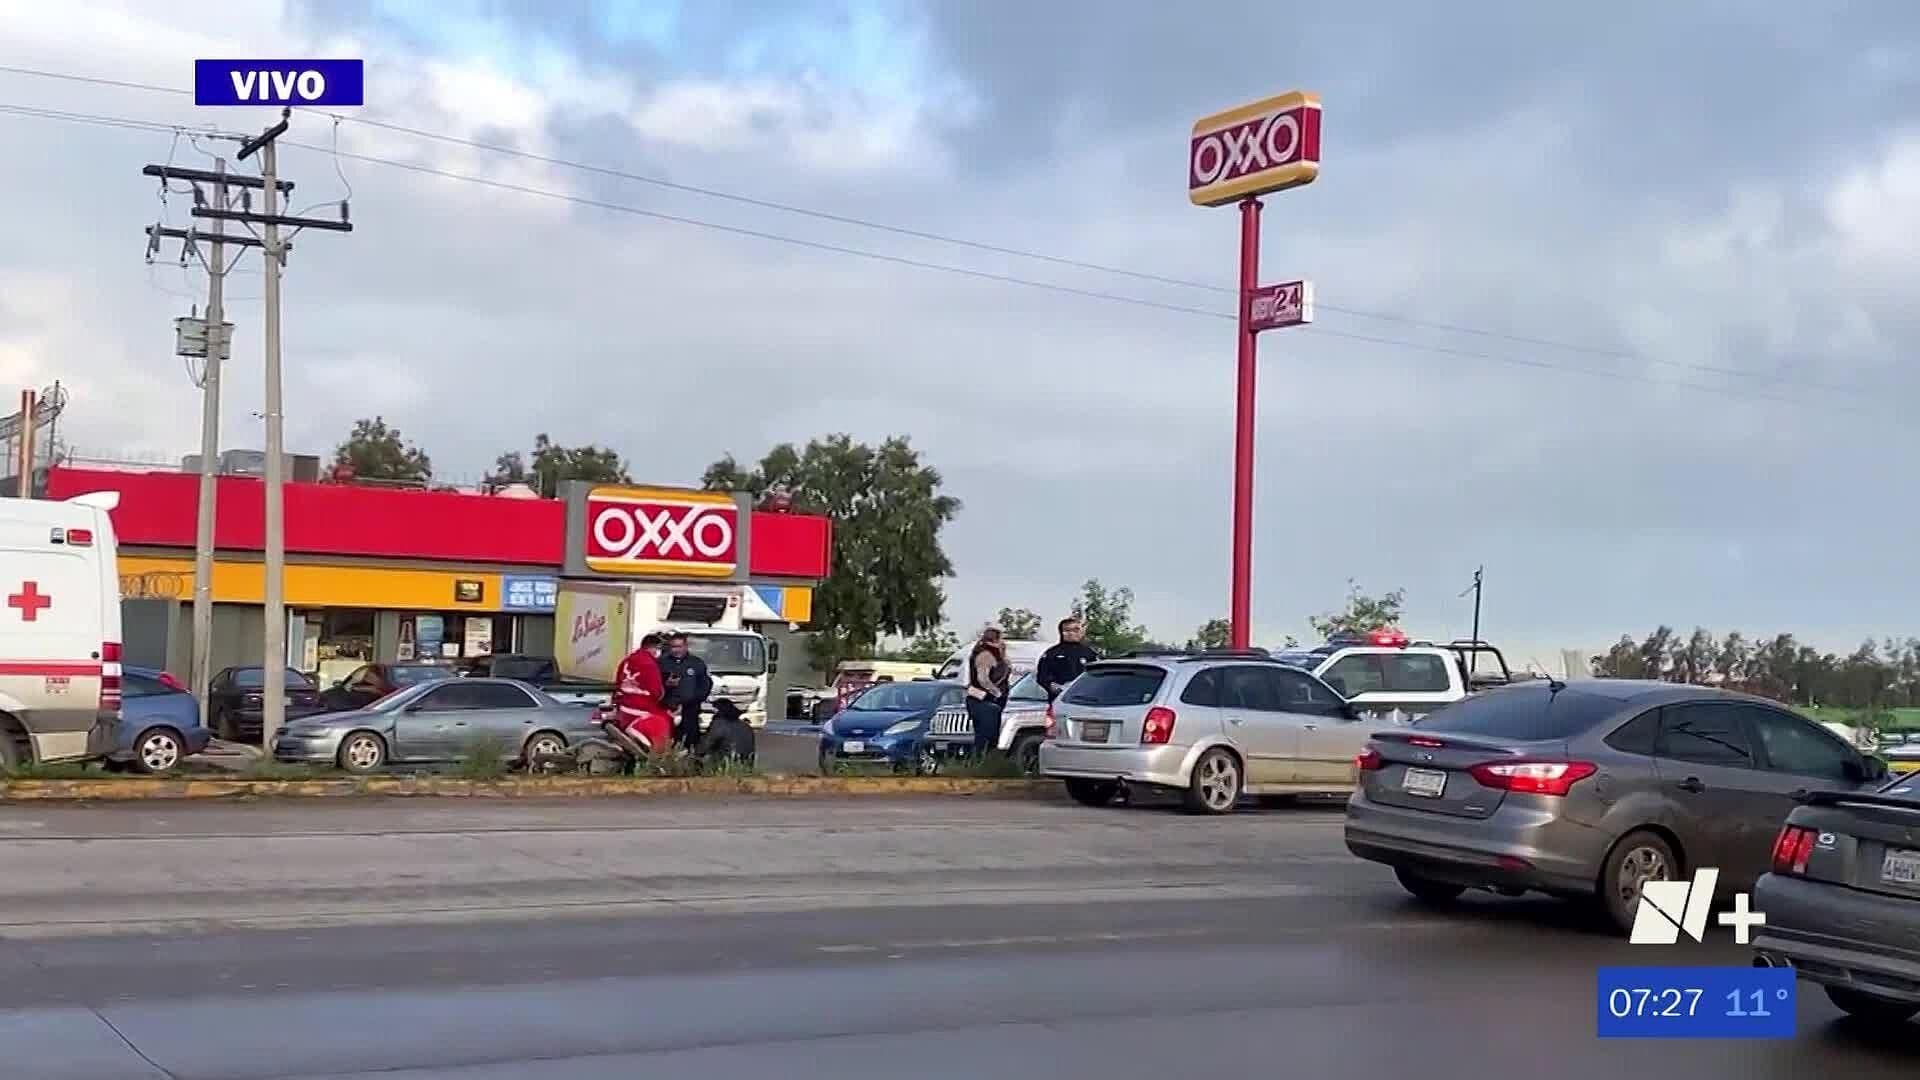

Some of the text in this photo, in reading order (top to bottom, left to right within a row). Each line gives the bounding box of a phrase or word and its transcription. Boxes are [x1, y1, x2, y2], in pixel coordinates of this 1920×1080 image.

[1193, 112, 1300, 184] OXXO
[1276, 287, 1301, 311] 24
[593, 504, 733, 559] OXXO
